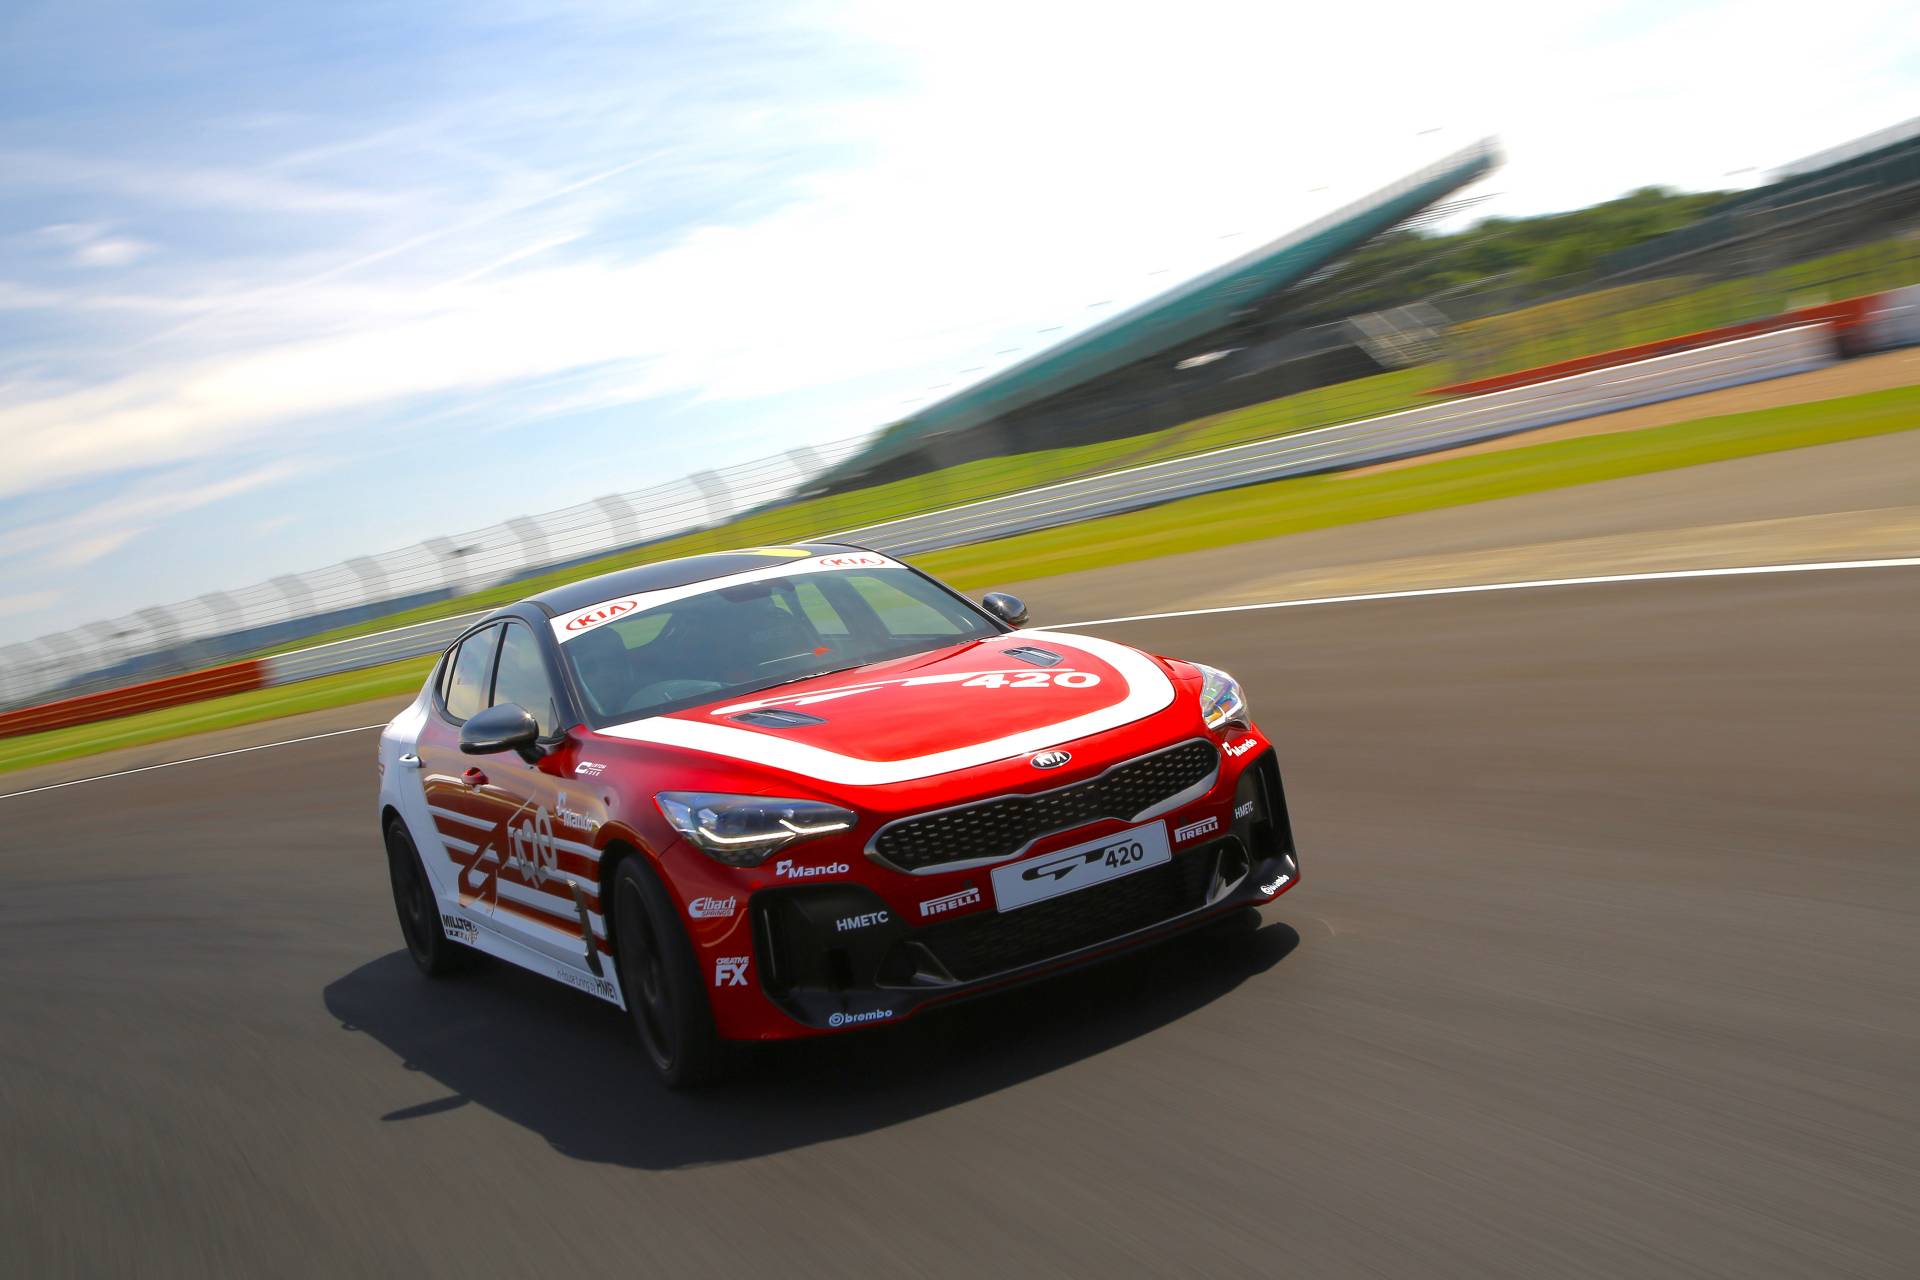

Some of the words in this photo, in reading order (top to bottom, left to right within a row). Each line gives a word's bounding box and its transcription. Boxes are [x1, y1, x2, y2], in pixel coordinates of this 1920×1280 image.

[576, 605, 627, 627] KIA
[962, 671, 1101, 689] 420
[1232, 738, 1257, 757] Mando
[1037, 751, 1070, 768] KIA
[1234, 801, 1254, 819] HMETC
[1174, 816, 1219, 843] PIRELLI
[1105, 842, 1144, 869] 420
[788, 862, 850, 879] Mando
[688, 896, 737, 918] Eibach
[919, 887, 981, 917] PIRELLI
[836, 911, 889, 932] HMETC
[715, 964, 749, 986] FX
[844, 1008, 893, 1024] brembo
